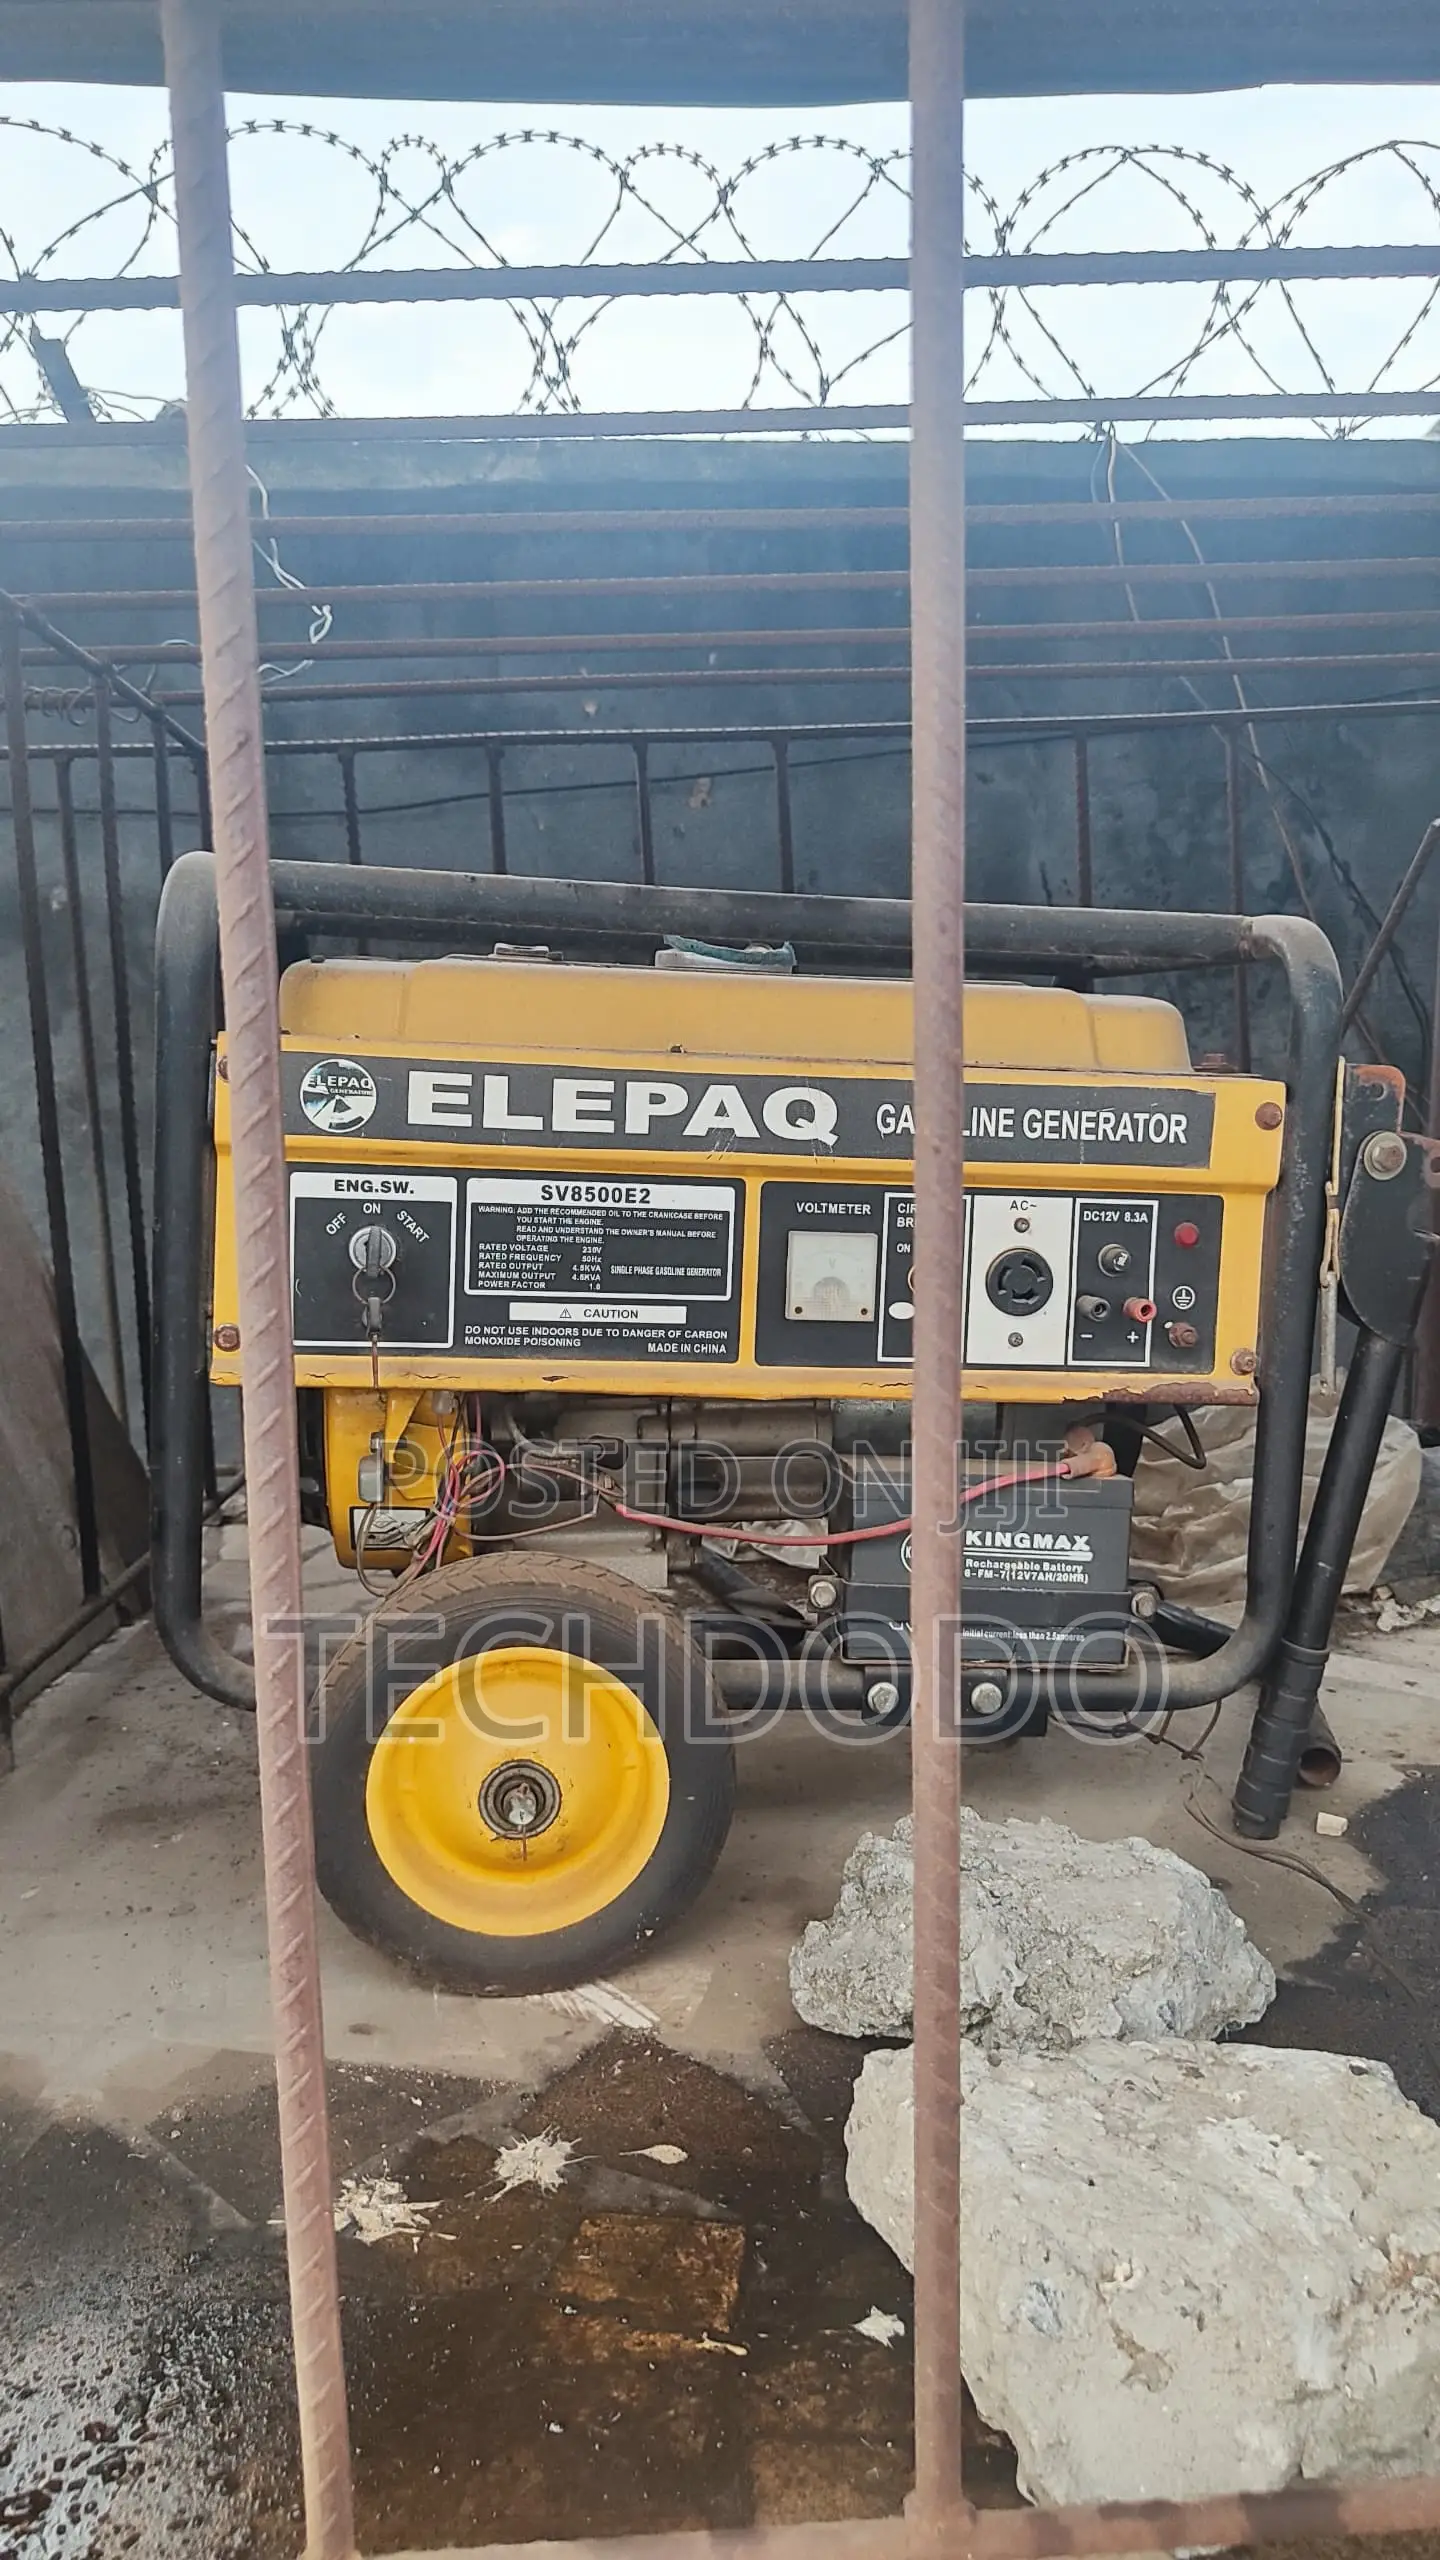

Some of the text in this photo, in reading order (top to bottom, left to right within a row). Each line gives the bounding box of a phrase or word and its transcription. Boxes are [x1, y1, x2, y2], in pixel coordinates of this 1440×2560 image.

[307, 1075, 373, 1090] ELEPAQ
[406, 1069, 840, 1146] ELEPAQ
[876, 1103, 1188, 1145] GAINE GENERATOR
[334, 1179, 415, 1194] ENG.SW.
[540, 1185, 652, 1204] SV8500E2
[363, 1203, 381, 1214] ON
[478, 1206, 515, 1214] WARNING:
[550, 1208, 606, 1216] RECOMMENDED
[648, 1212, 692, 1220] CRANKCASE
[796, 1202, 871, 1215] VOLTMETER
[574, 1218, 604, 1226] ENGINE.
[1083, 1210, 1149, 1223] DC12V 8.3A
[325, 1211, 348, 1236] OFF
[395, 1210, 430, 1244] START
[555, 1226, 604, 1234] UNDERSTAND
[516, 1235, 558, 1243] OPERATING
[479, 1243, 602, 1254] RATED VOLTAGE 230V
[896, 1243, 911, 1253] ON
[478, 1252, 507, 1260] RATED
[509, 1253, 562, 1262] FREQUENCY
[509, 1262, 543, 1270] OUTPUT
[611, 1265, 722, 1277] SINGLE PHASE GASOLINE GENERATOR
[478, 1271, 520, 1279] MAXIMUM
[522, 1272, 556, 1280] OUTPUT
[478, 1280, 509, 1288] POWER
[511, 1281, 545, 1289] FACTOR
[583, 1309, 639, 1319] CAUTION
[465, 1326, 728, 1340] DO NOT USE INDOORS DUE TO DANGER OF CARBON
[464, 1336, 581, 1347] MONOXIDE POISONING
[648, 1343, 726, 1354] MADE IN CHINA
[965, 1530, 1091, 1552] KINGMAX
[965, 1558, 1083, 1574] Rechargeable Battery
[1029, 1631, 1044, 1640] than
